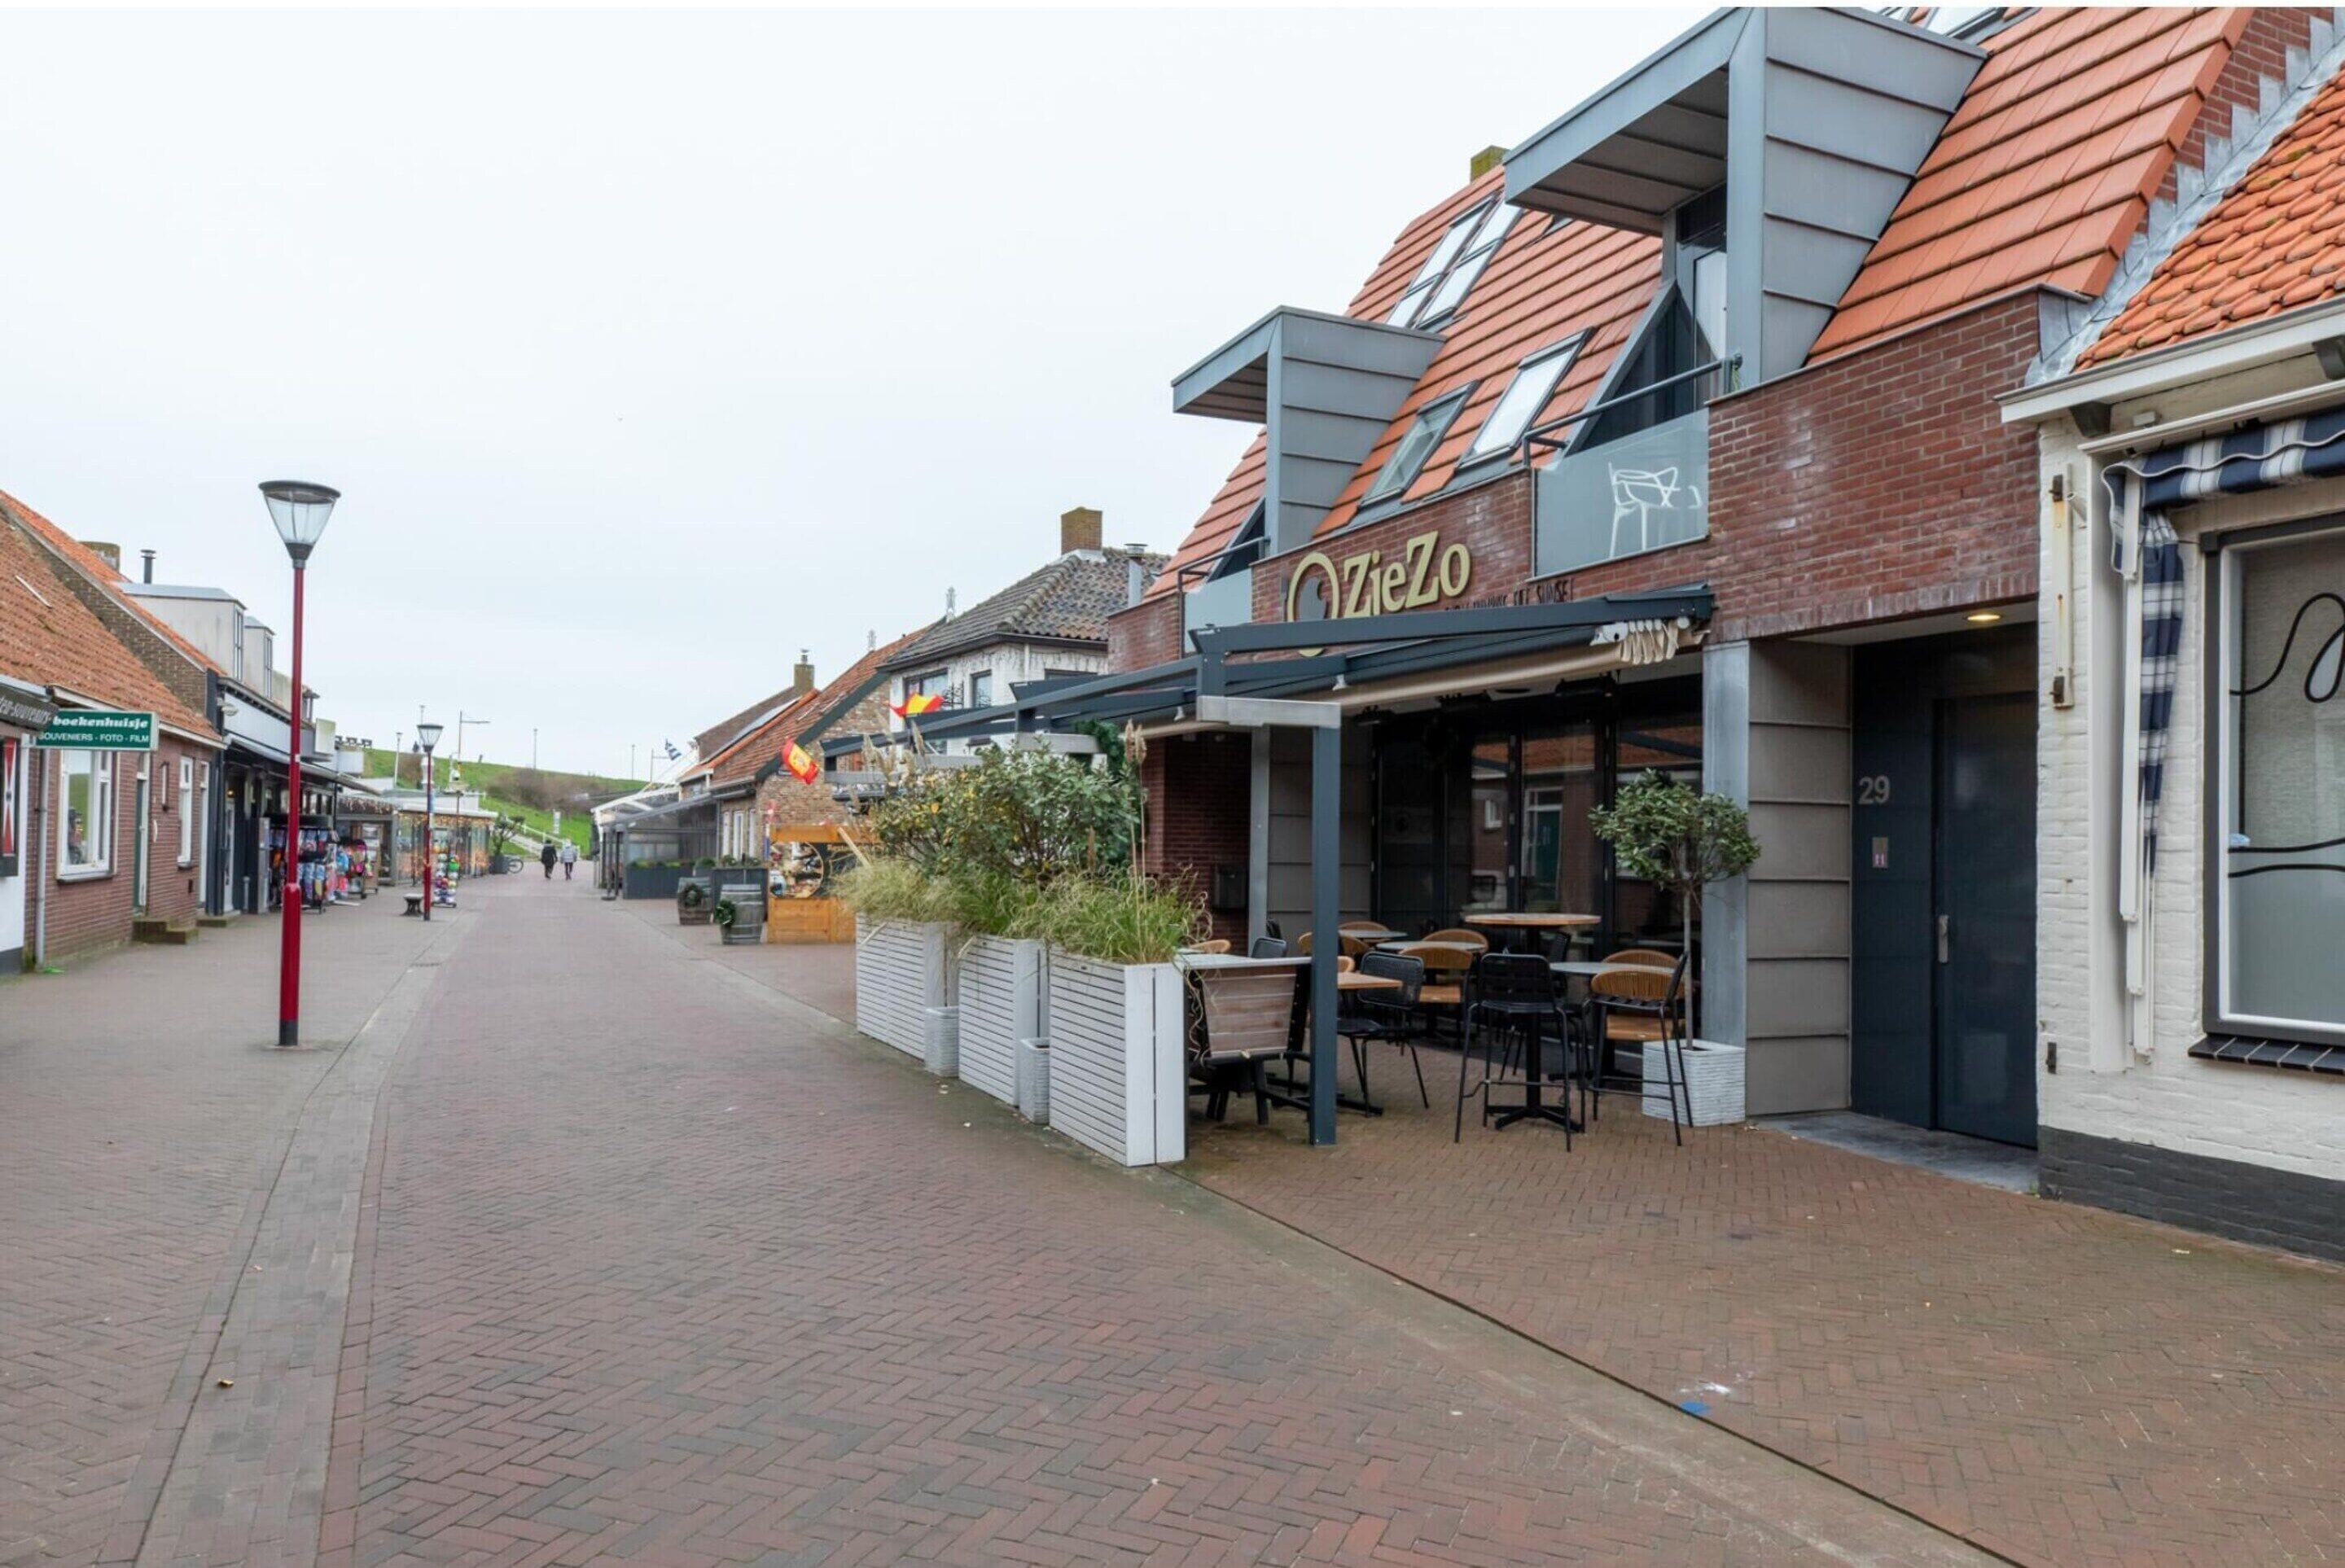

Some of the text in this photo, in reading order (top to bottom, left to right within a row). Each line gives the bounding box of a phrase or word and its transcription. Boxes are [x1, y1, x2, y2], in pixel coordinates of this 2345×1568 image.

[1343, 531, 1471, 619] ZieZo
[53, 716, 148, 730] boekenhuisje
[100, 734, 124, 742] FOTO
[130, 734, 149, 742] FILM
[1858, 776, 1890, 804] 29
